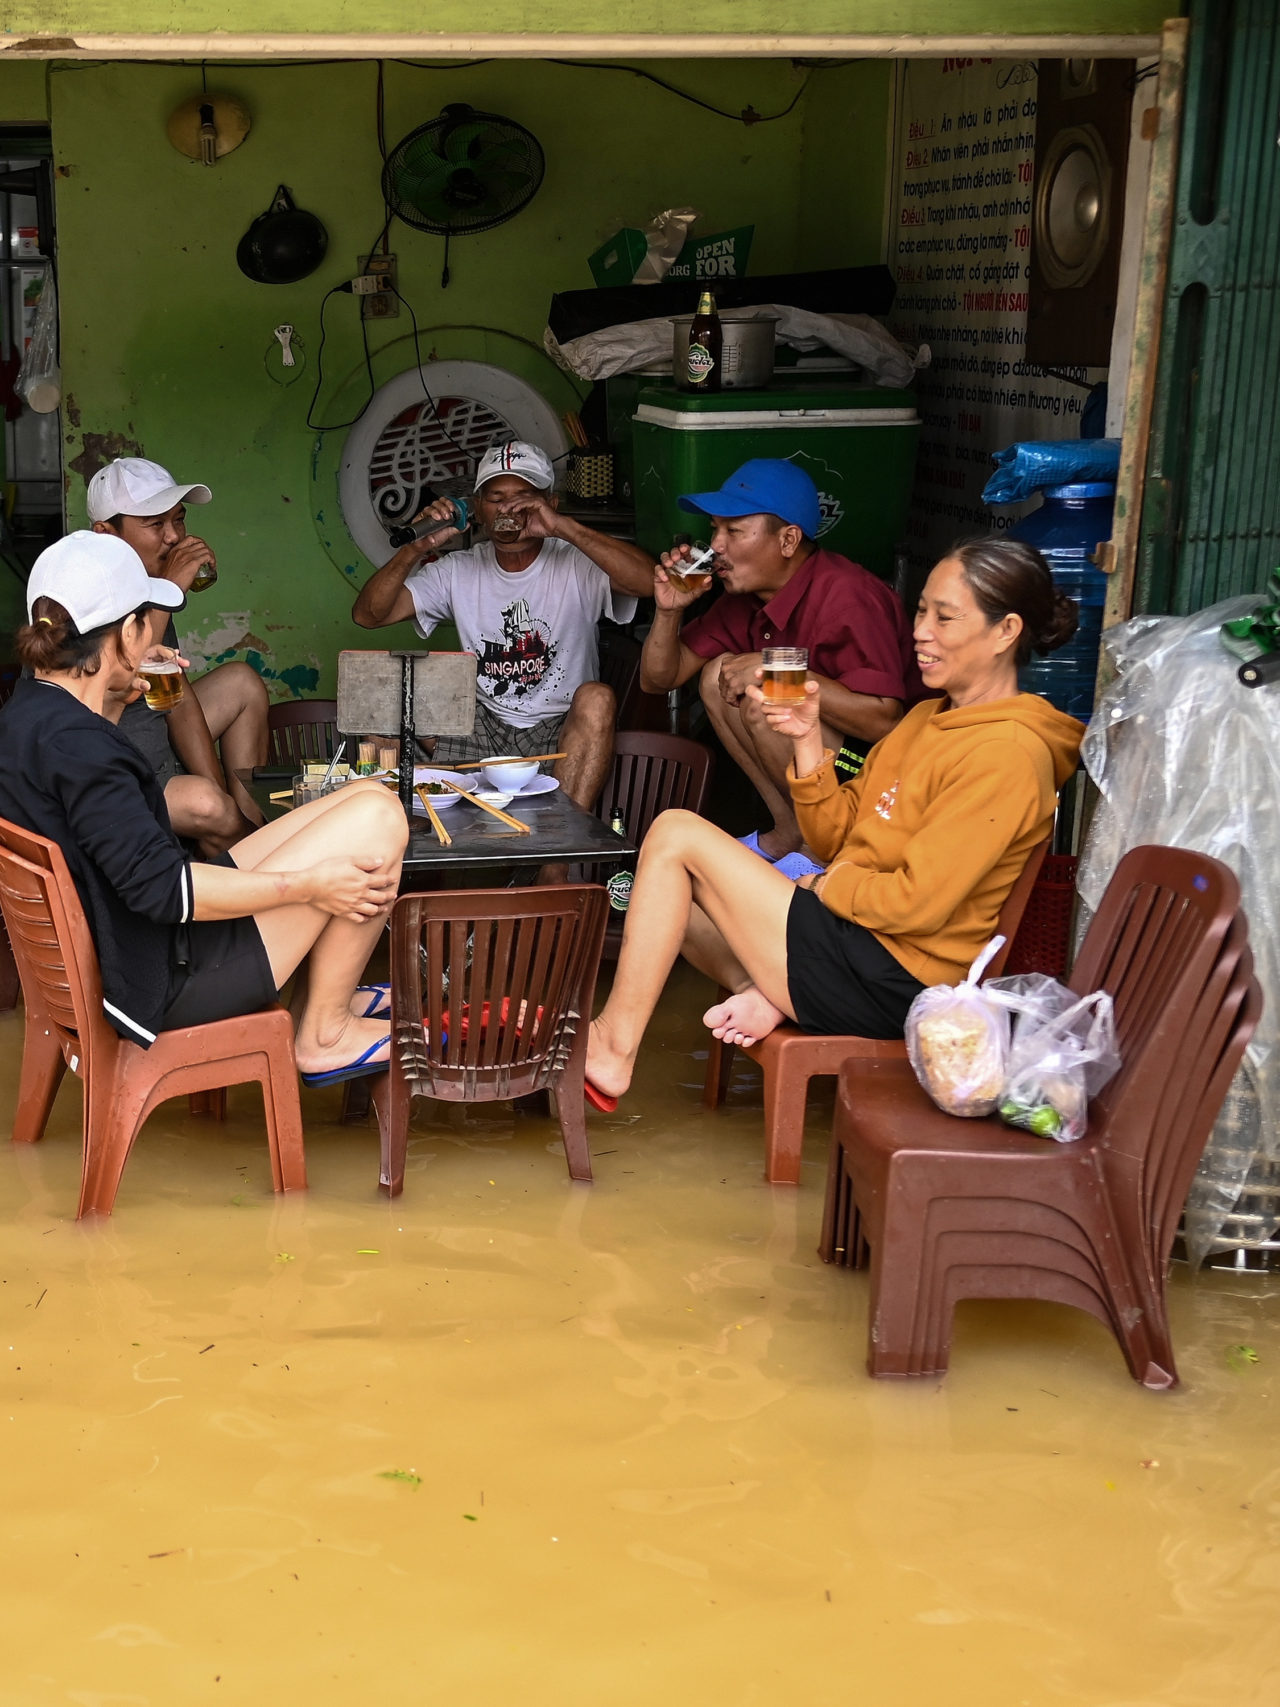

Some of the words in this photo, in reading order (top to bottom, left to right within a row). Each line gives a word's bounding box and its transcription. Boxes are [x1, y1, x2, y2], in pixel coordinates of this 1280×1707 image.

[695, 237, 736, 260] OPEN
[666, 264, 691, 277] ORG
[695, 255, 737, 276] FOR
[1008, 293, 1029, 312] SAU
[484, 655, 546, 676] SINGAPORE
